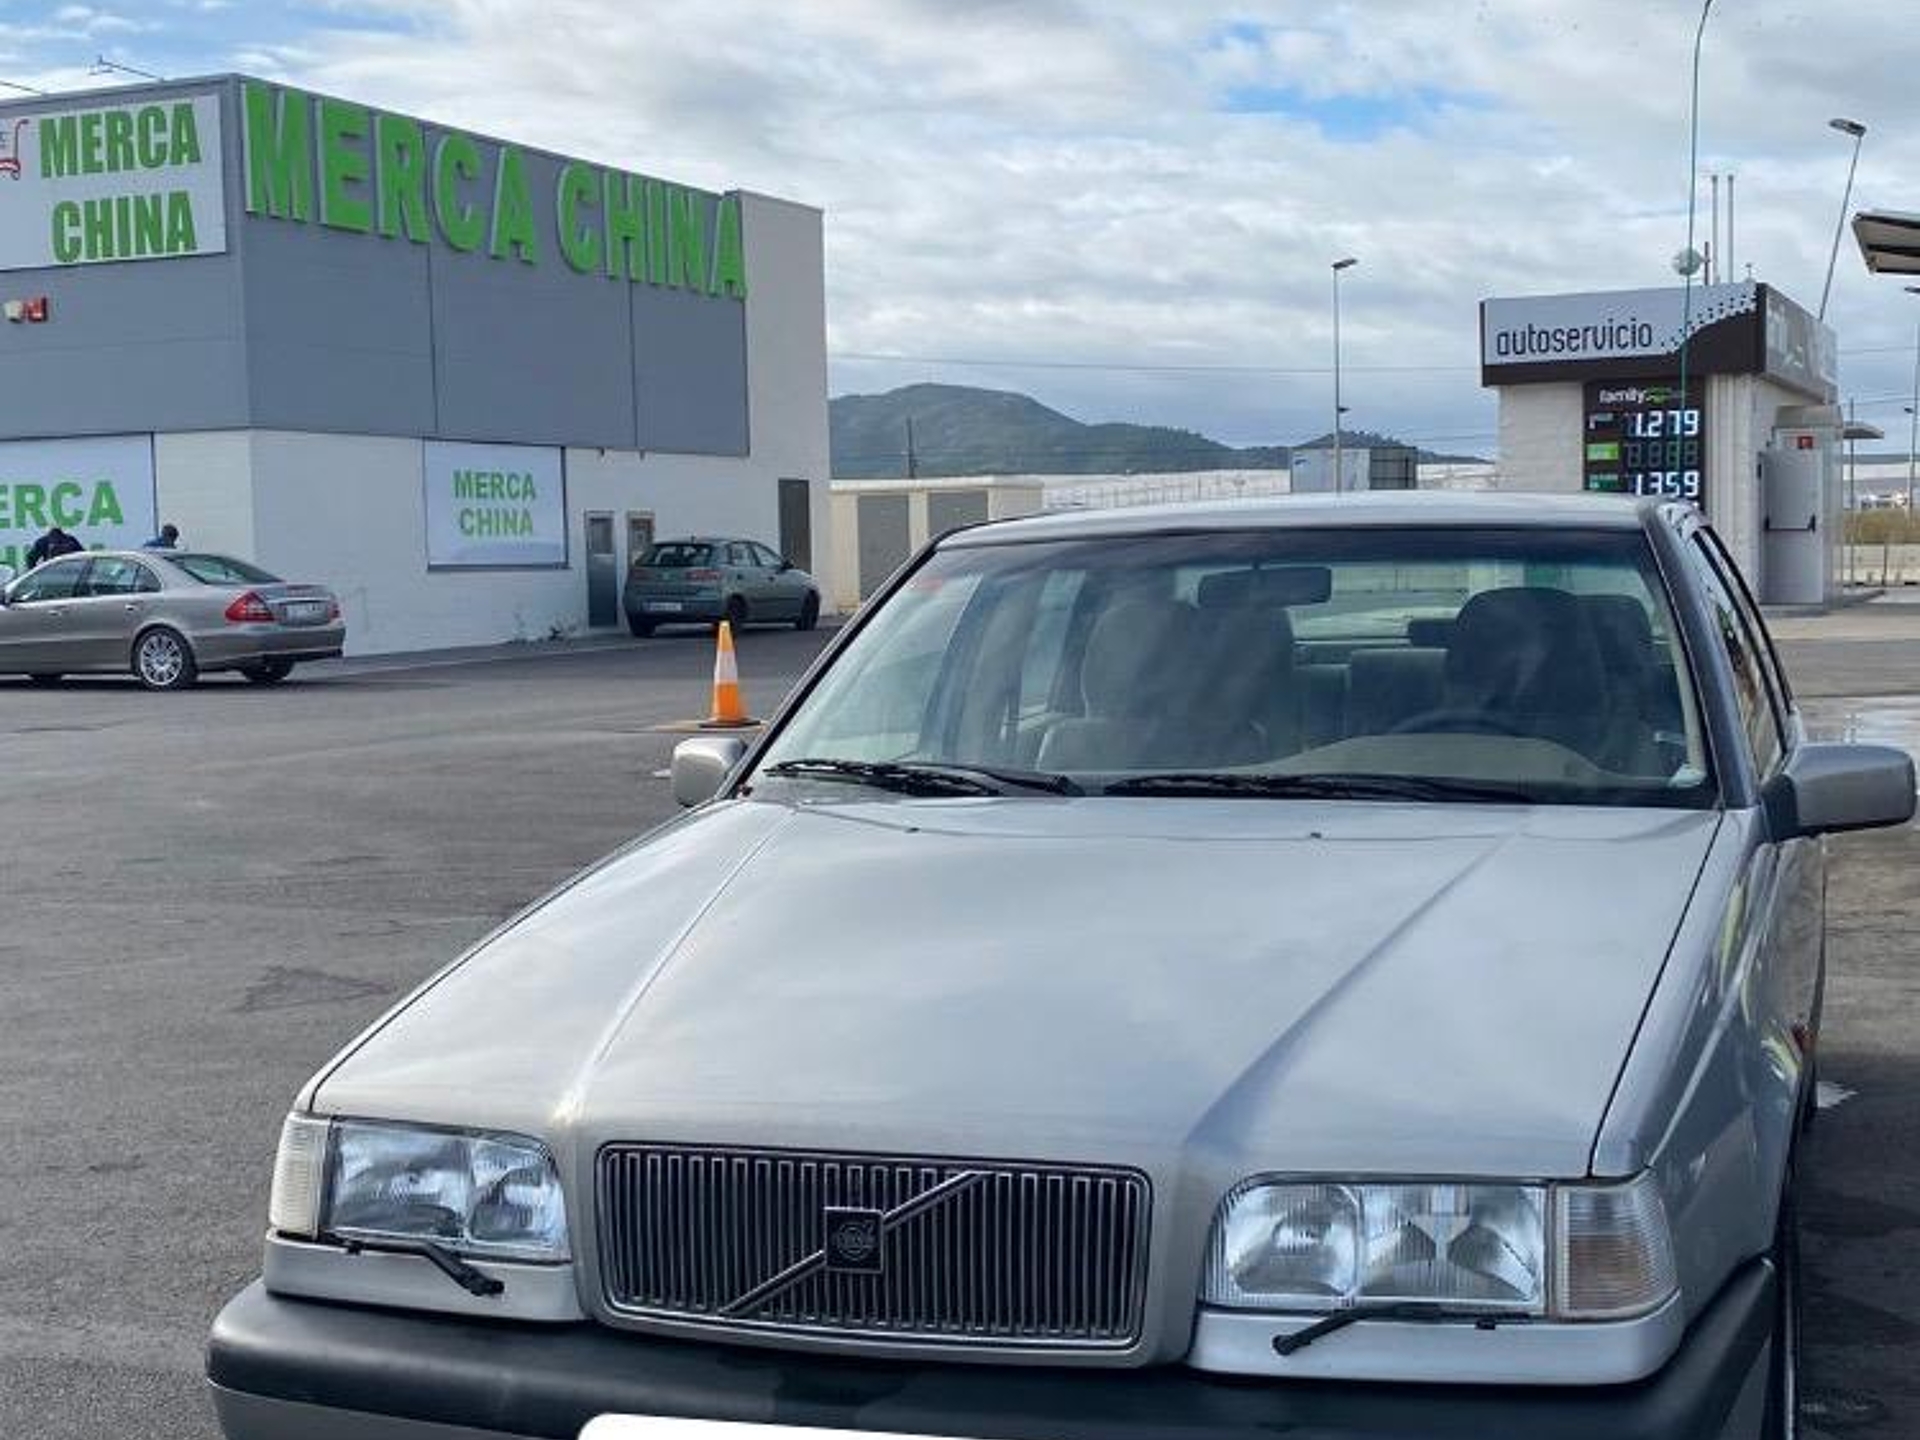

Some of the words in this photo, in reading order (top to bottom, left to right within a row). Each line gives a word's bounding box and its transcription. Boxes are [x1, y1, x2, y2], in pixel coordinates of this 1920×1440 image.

[40, 103, 200, 178] MERCA
[241, 80, 535, 266] MERCA
[557, 159, 747, 298] CHINA
[52, 190, 197, 263] CHINA
[1496, 318, 1653, 356] autoservicio
[453, 469, 536, 499] MERCA
[460, 507, 534, 536] CHINA
